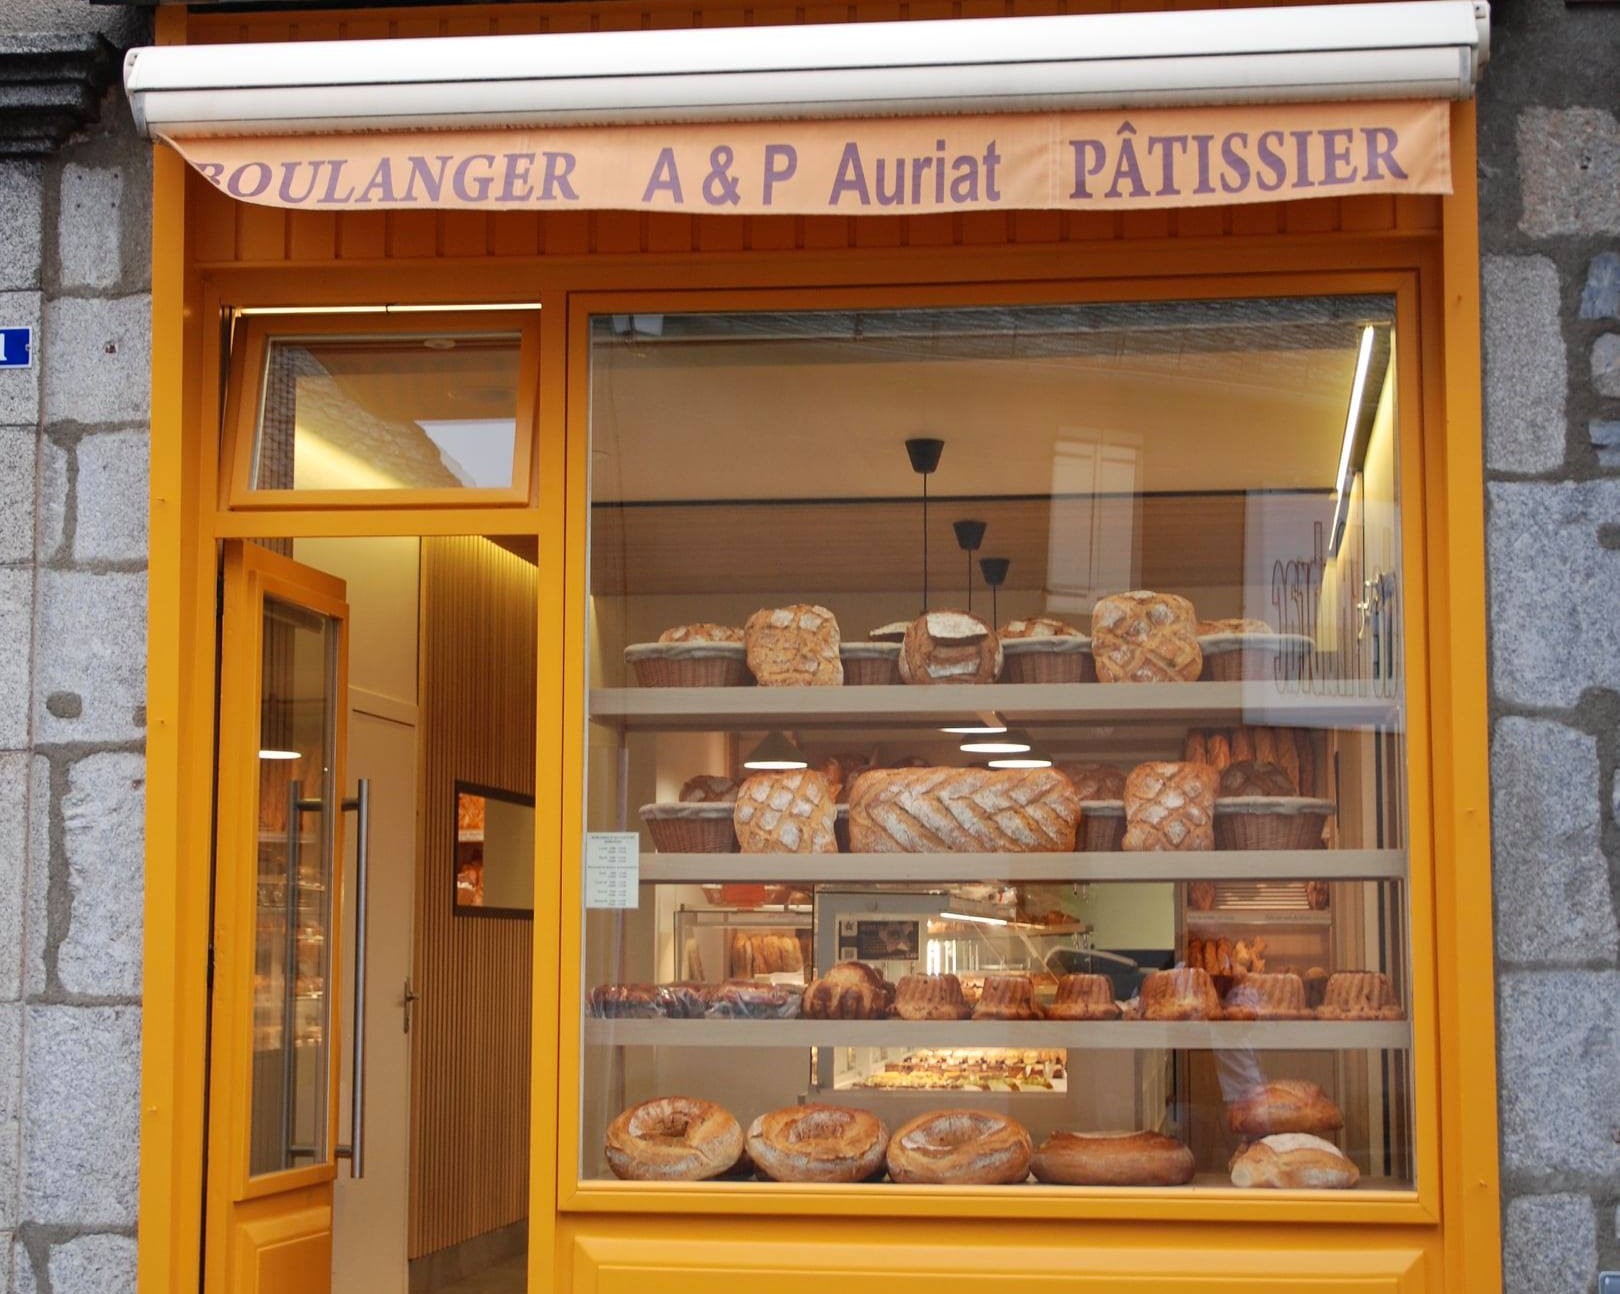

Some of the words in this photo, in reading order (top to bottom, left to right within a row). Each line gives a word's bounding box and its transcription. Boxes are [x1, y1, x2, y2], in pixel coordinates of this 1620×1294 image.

[641, 147, 684, 203] A
[702, 145, 741, 206] &
[762, 144, 798, 205] P
[828, 139, 1001, 206] Auriat
[1069, 120, 1409, 199] PÂTISSIER
